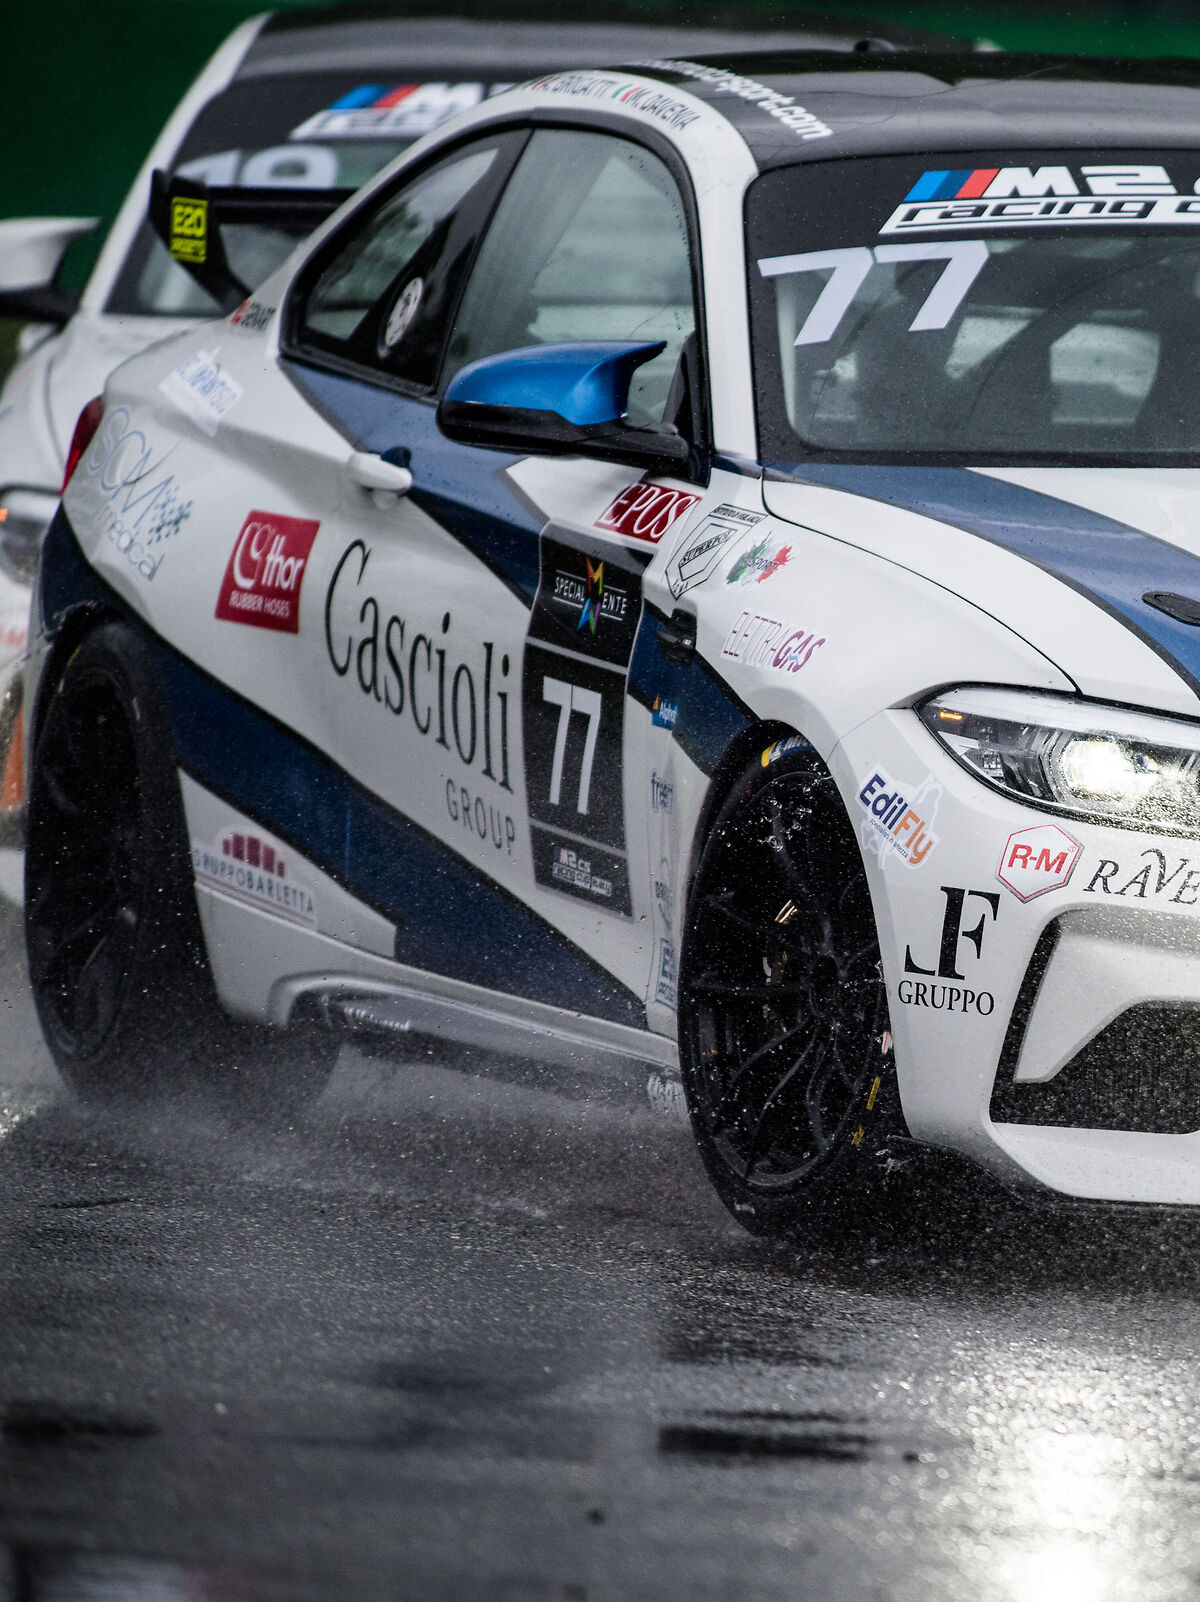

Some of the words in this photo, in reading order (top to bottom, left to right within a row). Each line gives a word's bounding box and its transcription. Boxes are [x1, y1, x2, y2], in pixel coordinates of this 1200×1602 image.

[900, 199, 1159, 222] racing
[981, 165, 1177, 198] M2
[757, 240, 990, 346] 77
[597, 482, 702, 539] EPOS
[324, 538, 514, 795] Cascioli
[543, 675, 602, 816] 77
[446, 778, 516, 857] GROUP
[860, 773, 934, 865] EdilFly
[1007, 843, 1069, 874] R-M
[898, 979, 996, 1017] GRUPPO
